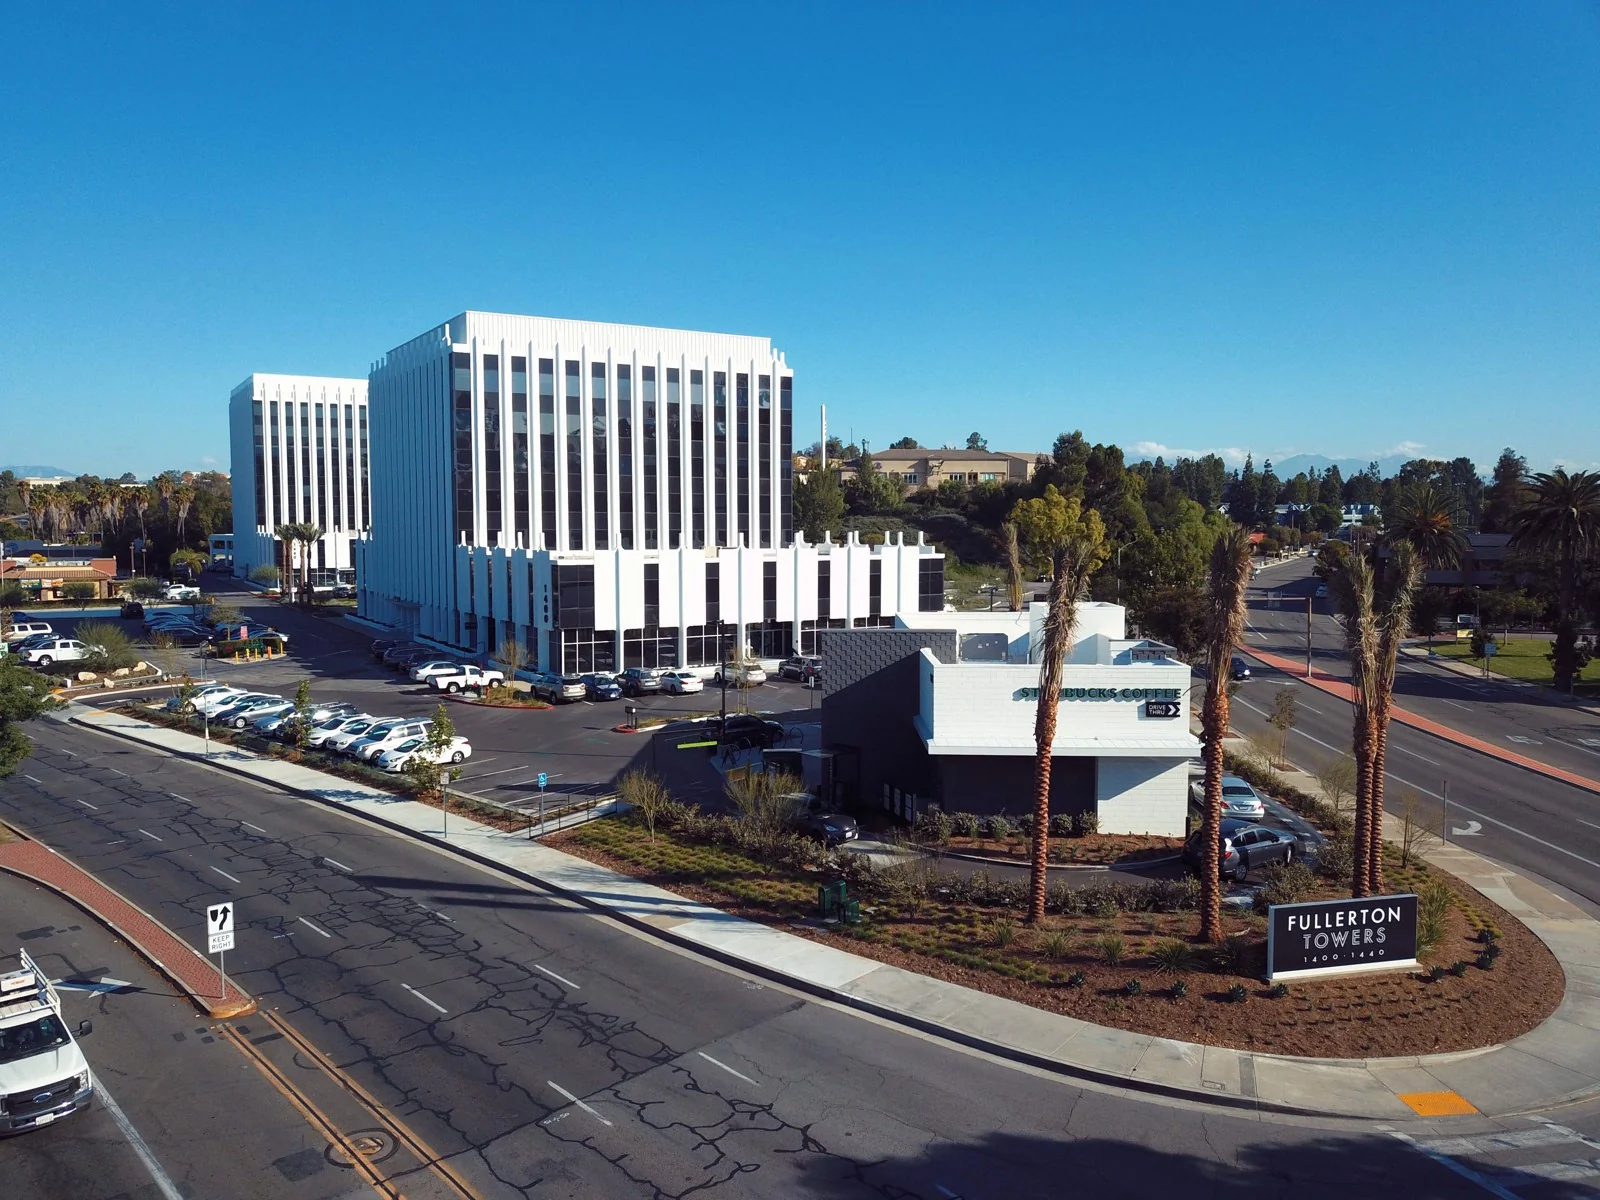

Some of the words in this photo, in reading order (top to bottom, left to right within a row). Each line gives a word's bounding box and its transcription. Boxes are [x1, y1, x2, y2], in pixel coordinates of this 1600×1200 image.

[1021, 687, 1117, 699] STBUCKS
[1121, 687, 1182, 699] COFFEE
[1288, 906, 1401, 931] FULLERTON
[212, 935, 230, 943] KEEP
[1303, 927, 1387, 950] TOWERS
[212, 941, 231, 950] RIGHT
